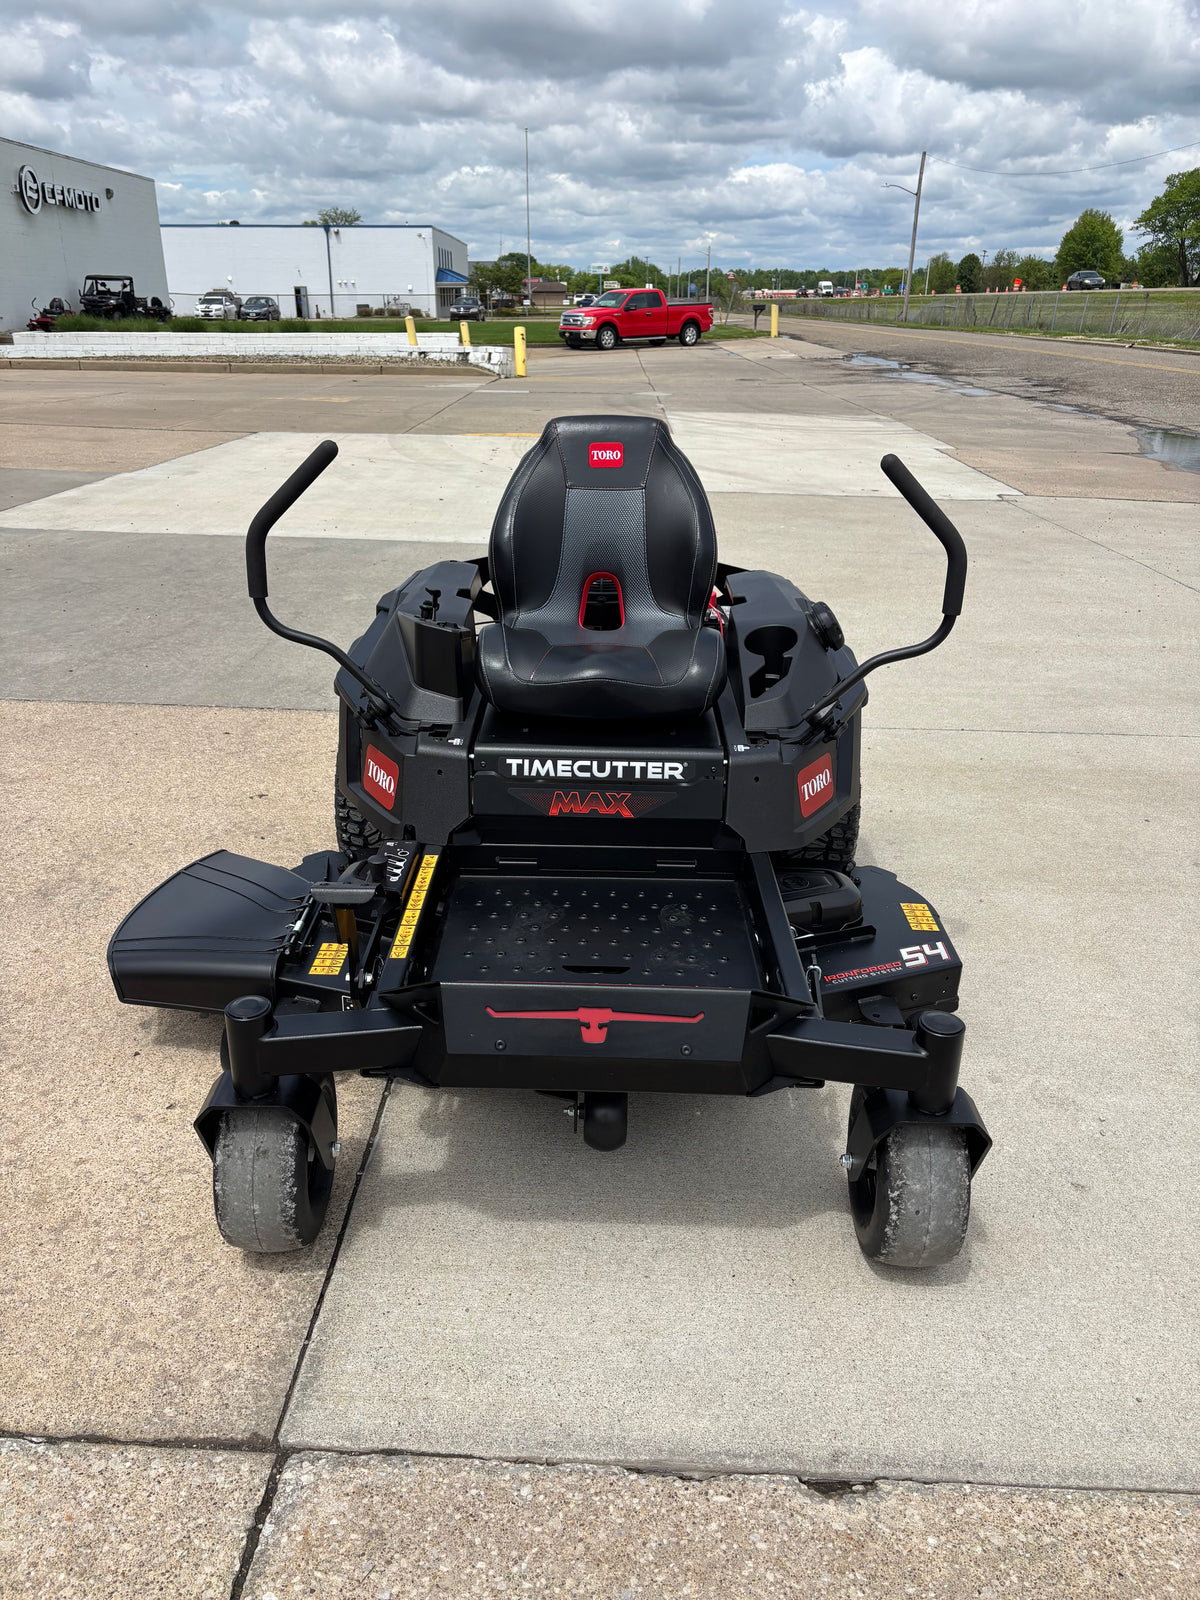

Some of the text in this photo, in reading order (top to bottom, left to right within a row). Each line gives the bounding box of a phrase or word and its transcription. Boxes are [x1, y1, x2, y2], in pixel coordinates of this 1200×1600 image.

[42, 182, 101, 212] CFMOTO
[591, 450, 621, 460] TORO
[368, 759, 395, 793] TORO
[506, 758, 685, 780] TIMECUTTER
[801, 769, 830, 801] TORO
[549, 791, 634, 817] MAX
[900, 941, 951, 968] 54
[824, 961, 902, 982] IRONFORGED
[831, 966, 902, 985] CUTTING SYSTEM
